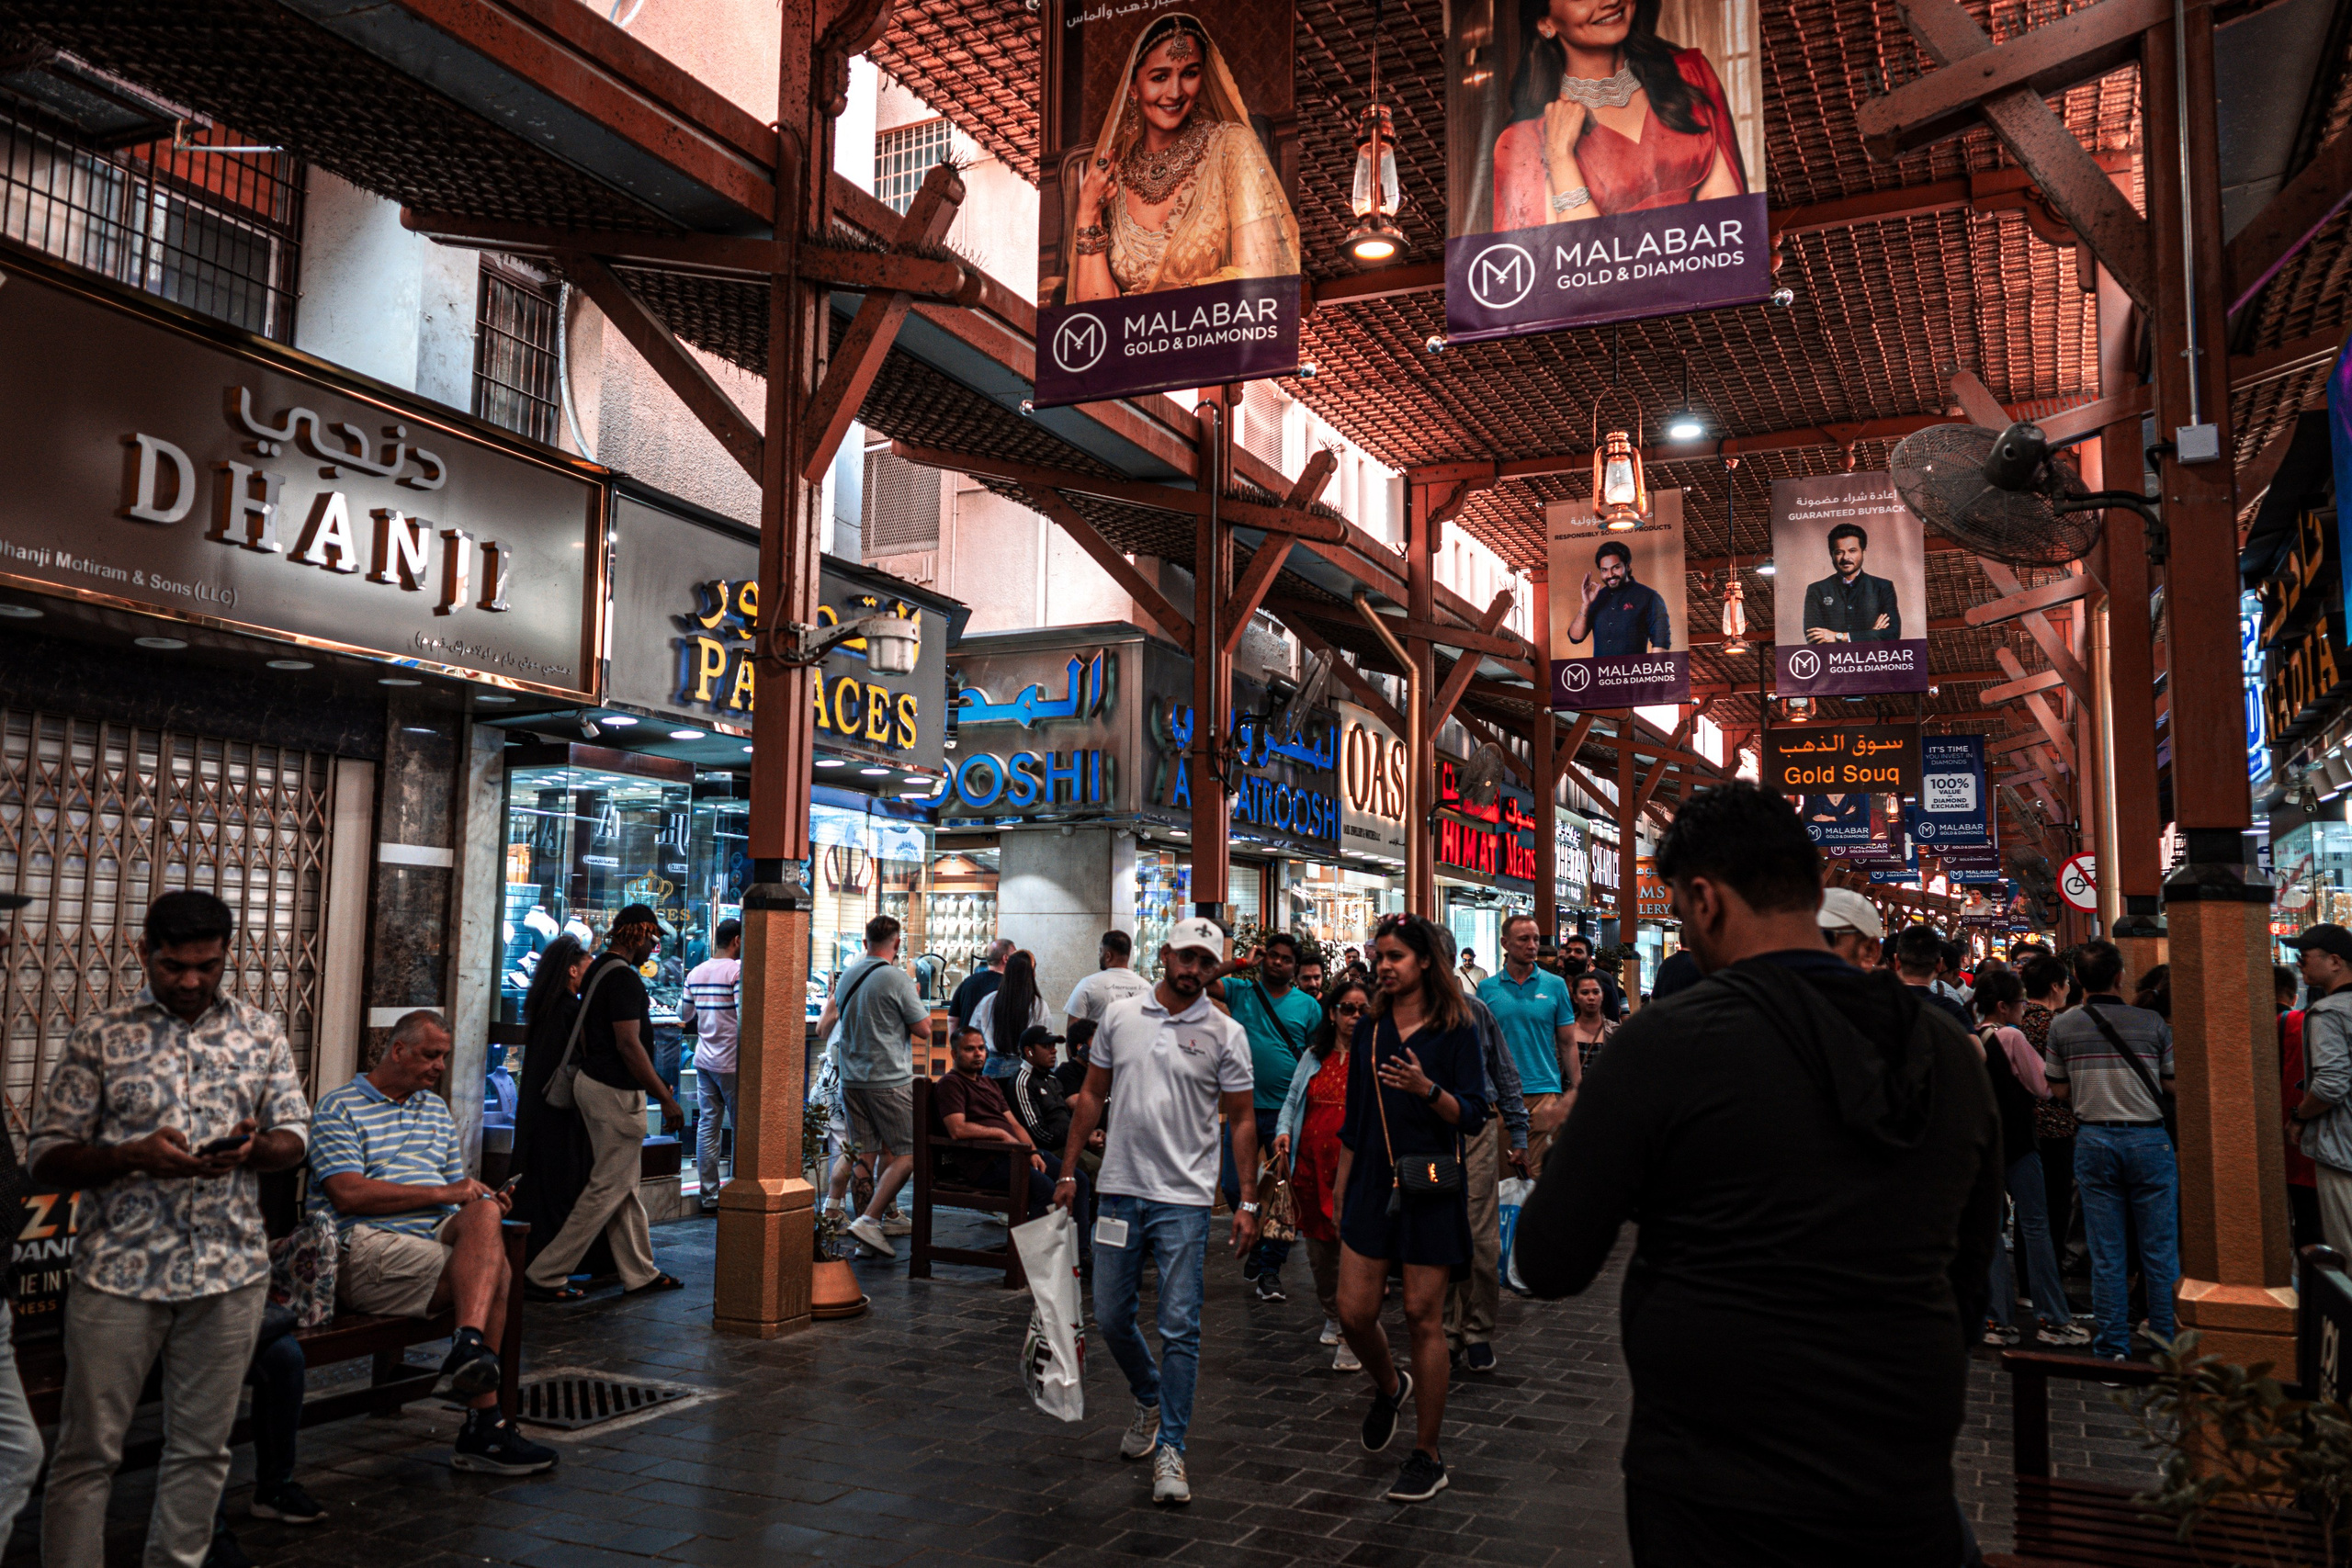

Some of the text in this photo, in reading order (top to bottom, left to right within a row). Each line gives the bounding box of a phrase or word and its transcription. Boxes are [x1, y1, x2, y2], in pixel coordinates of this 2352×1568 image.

[1067, 4, 1113, 28] وألماس
[1556, 220, 1744, 270] MALABAR
[1557, 251, 1745, 289] GOLD & DIAMONDS
[1124, 298, 1278, 339] MALABAR
[1124, 325, 1278, 356] GOLD & DIAMONDS
[125, 432, 512, 615] DHANJI
[1788, 504, 1906, 521] GUARANTEED BUYBACK
[1555, 532, 1600, 540] RESPONSIBLY
[1634, 524, 1672, 532] PRODUCTS
[55, 551, 127, 581] Motiram
[132, 570, 144, 586] &
[150, 574, 191, 596] Sons
[194, 580, 238, 608] (LLC)
[1829, 649, 1914, 664] MALABAR
[1864, 662, 1914, 671] DIAMONDS
[1599, 661, 1675, 677] MALABAR
[1599, 677, 1622, 685] GOLD
[1630, 674, 1675, 683] DIAMONDS
[2264, 615, 2340, 747] NADIA
[694, 635, 918, 750] PAACES
[1779, 734, 1904, 757] سوق الذهب
[1784, 764, 1900, 784] Gold Souq
[1930, 778, 1969, 789] 100%
[1441, 818, 1498, 875] HIMAT
